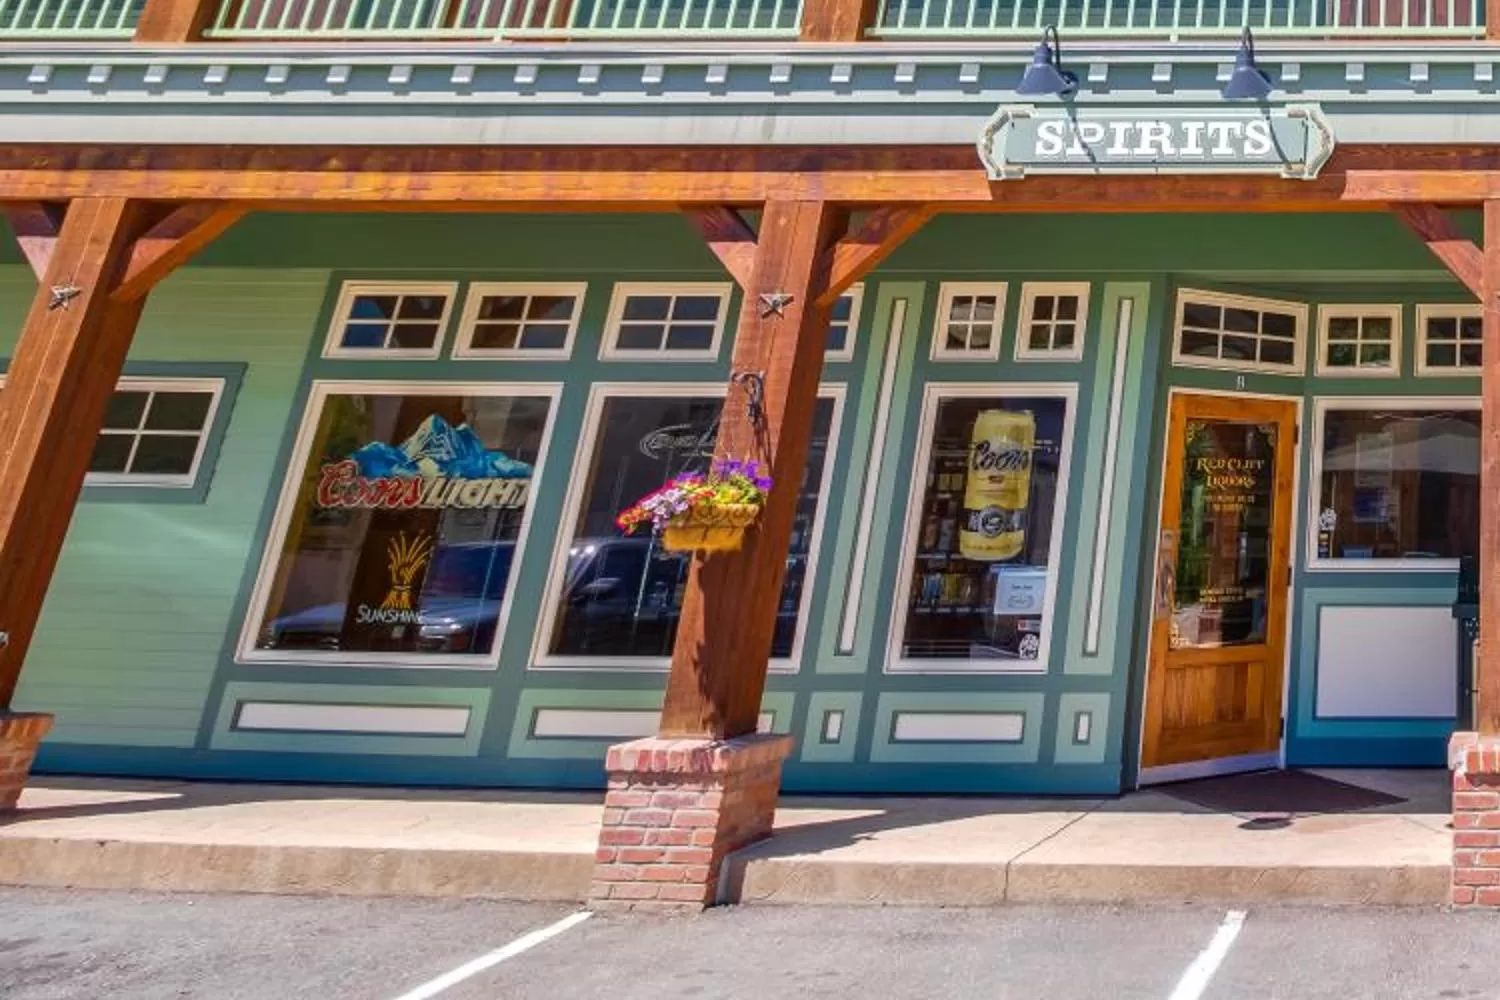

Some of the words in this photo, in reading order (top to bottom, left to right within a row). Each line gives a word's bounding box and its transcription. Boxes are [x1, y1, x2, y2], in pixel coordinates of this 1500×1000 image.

[1034, 119, 1274, 157] SPIRITS
[972, 440, 1029, 471] Coors
[317, 459, 423, 508] Coors
[422, 477, 533, 509] LIGHT
